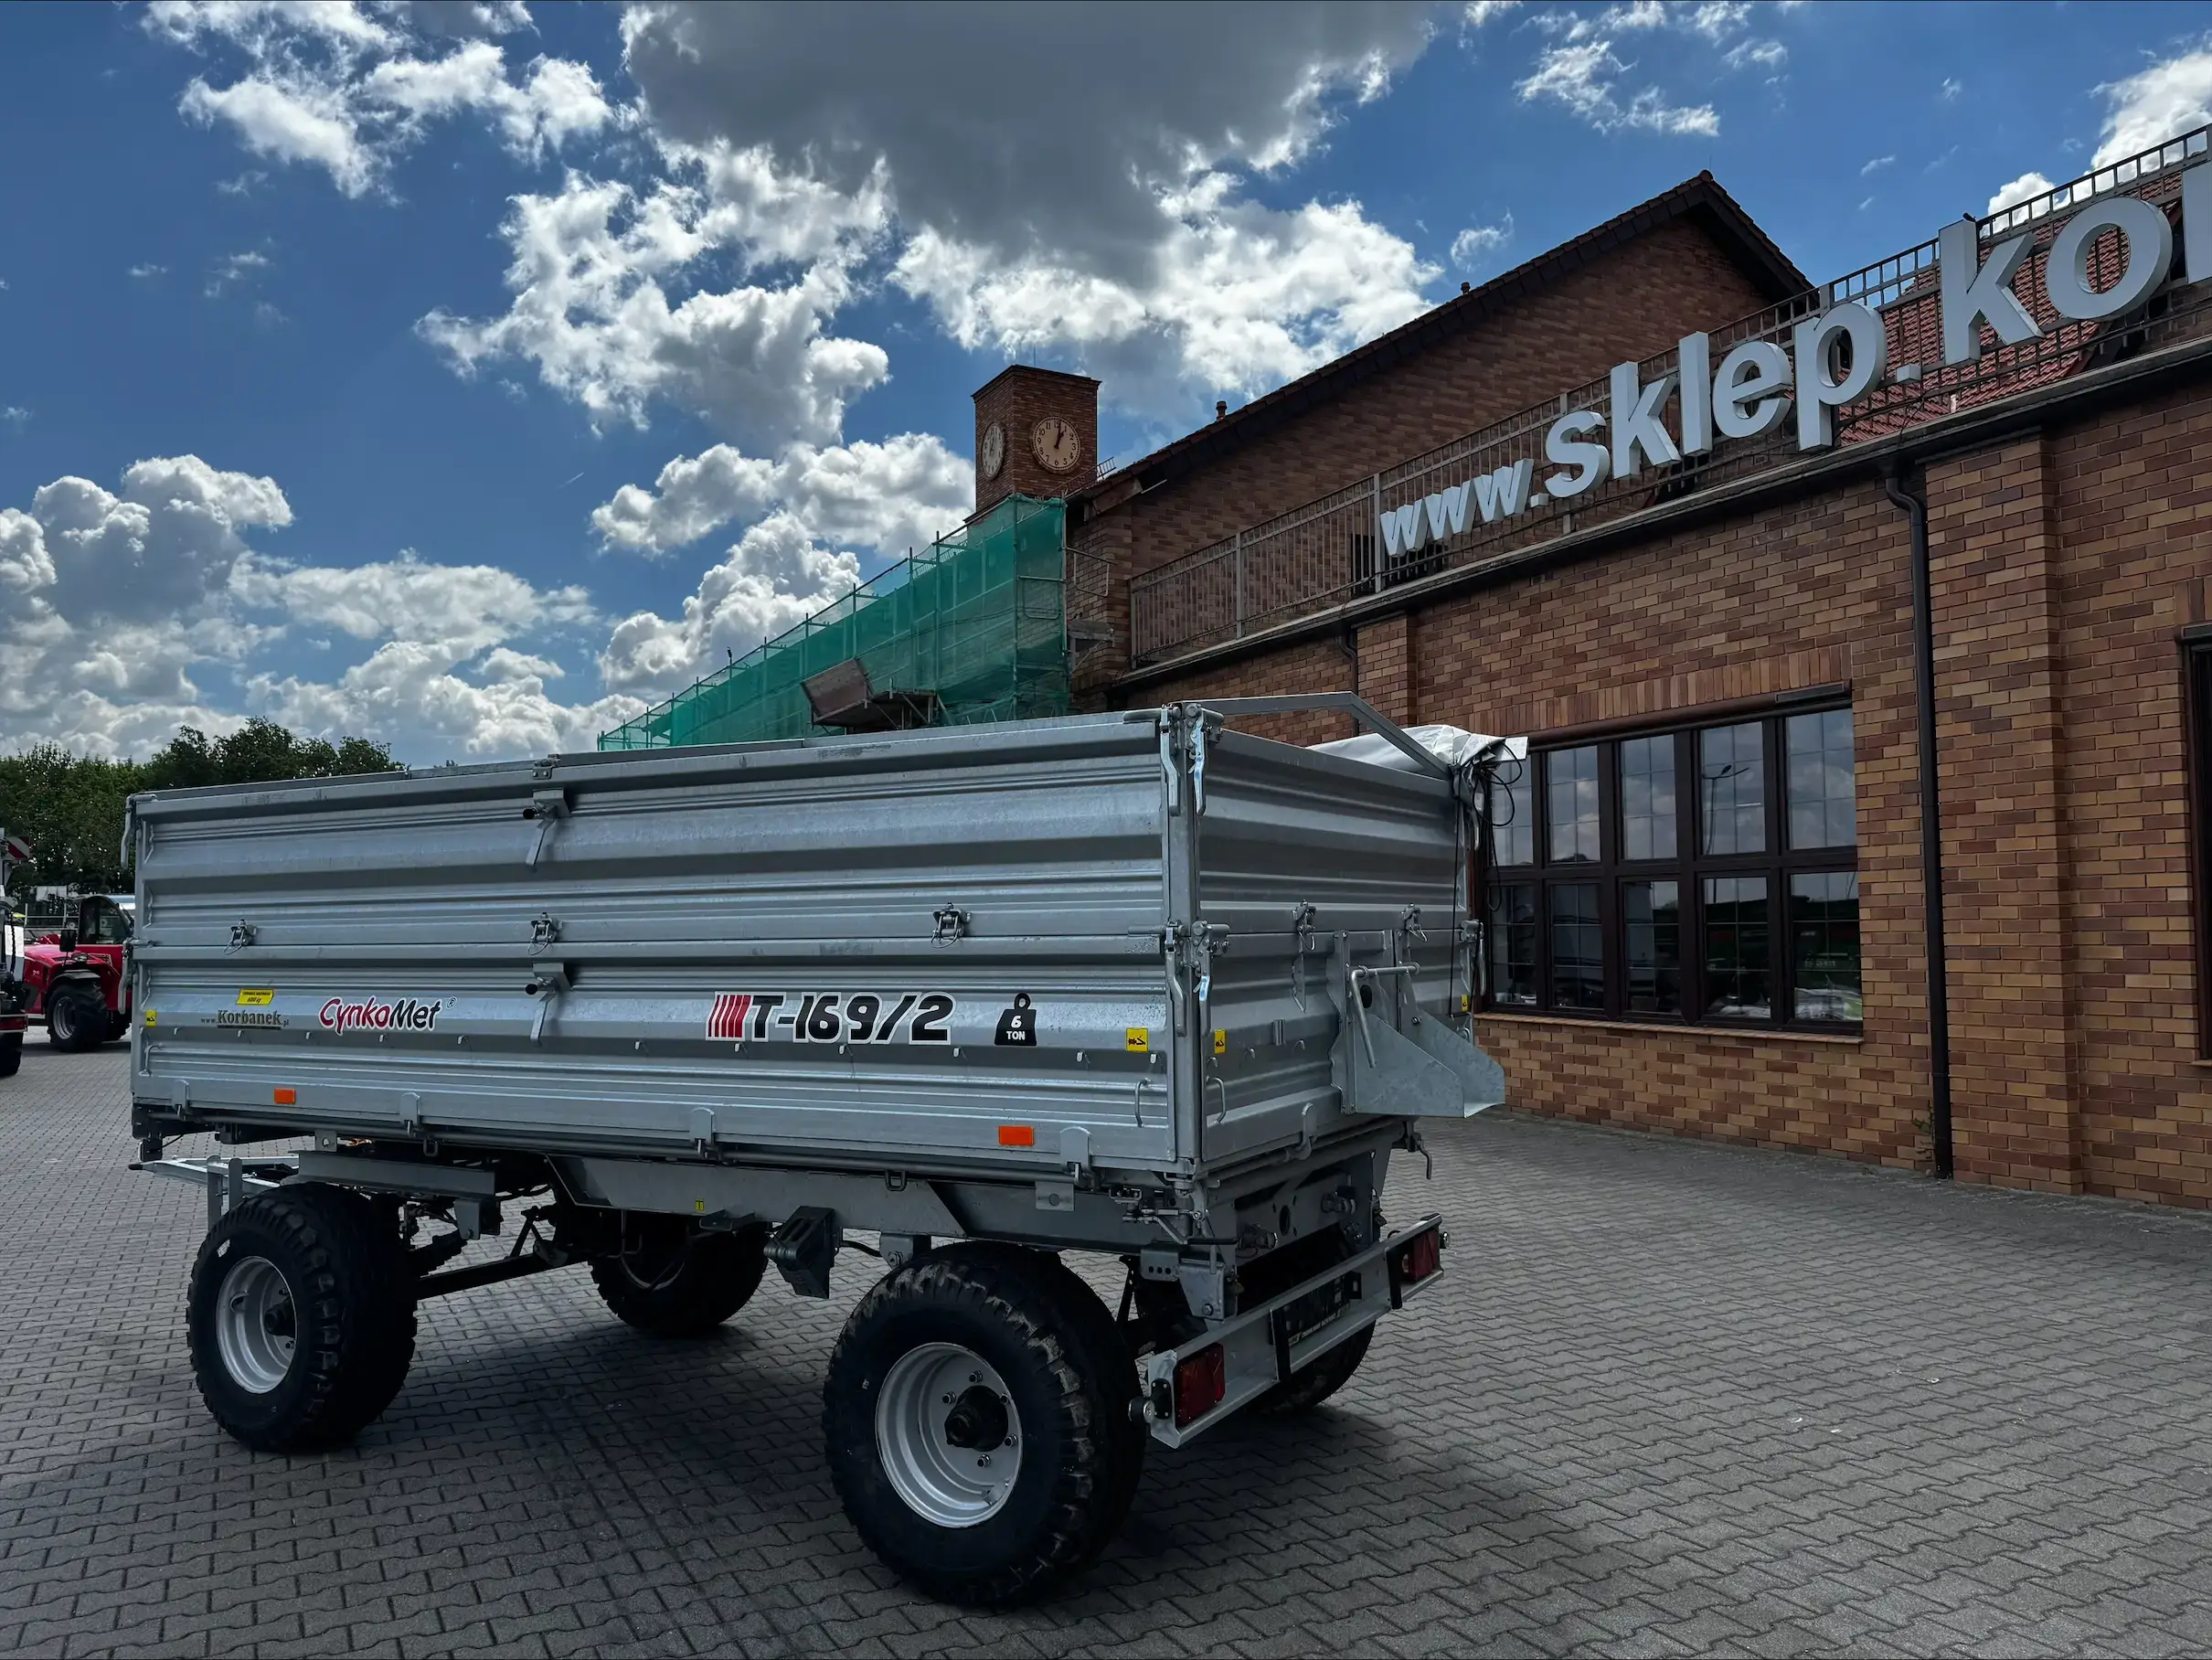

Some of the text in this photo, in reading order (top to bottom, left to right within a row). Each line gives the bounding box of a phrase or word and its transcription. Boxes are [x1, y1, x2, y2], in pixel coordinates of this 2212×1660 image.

[1046, 421, 1051, 430] 11
[1054, 420, 1060, 429] 12
[1038, 428, 1046, 436] 10
[1069, 432, 1074, 441] 2
[1071, 442, 1077, 451] 3
[1045, 454, 1050, 463] 7
[1063, 457, 1068, 465] 5
[320, 996, 442, 1035] CynkoMet
[751, 993, 956, 1044] T-169/2
[1011, 1015, 1021, 1028] 6
[1005, 1030, 1026, 1040] TON
